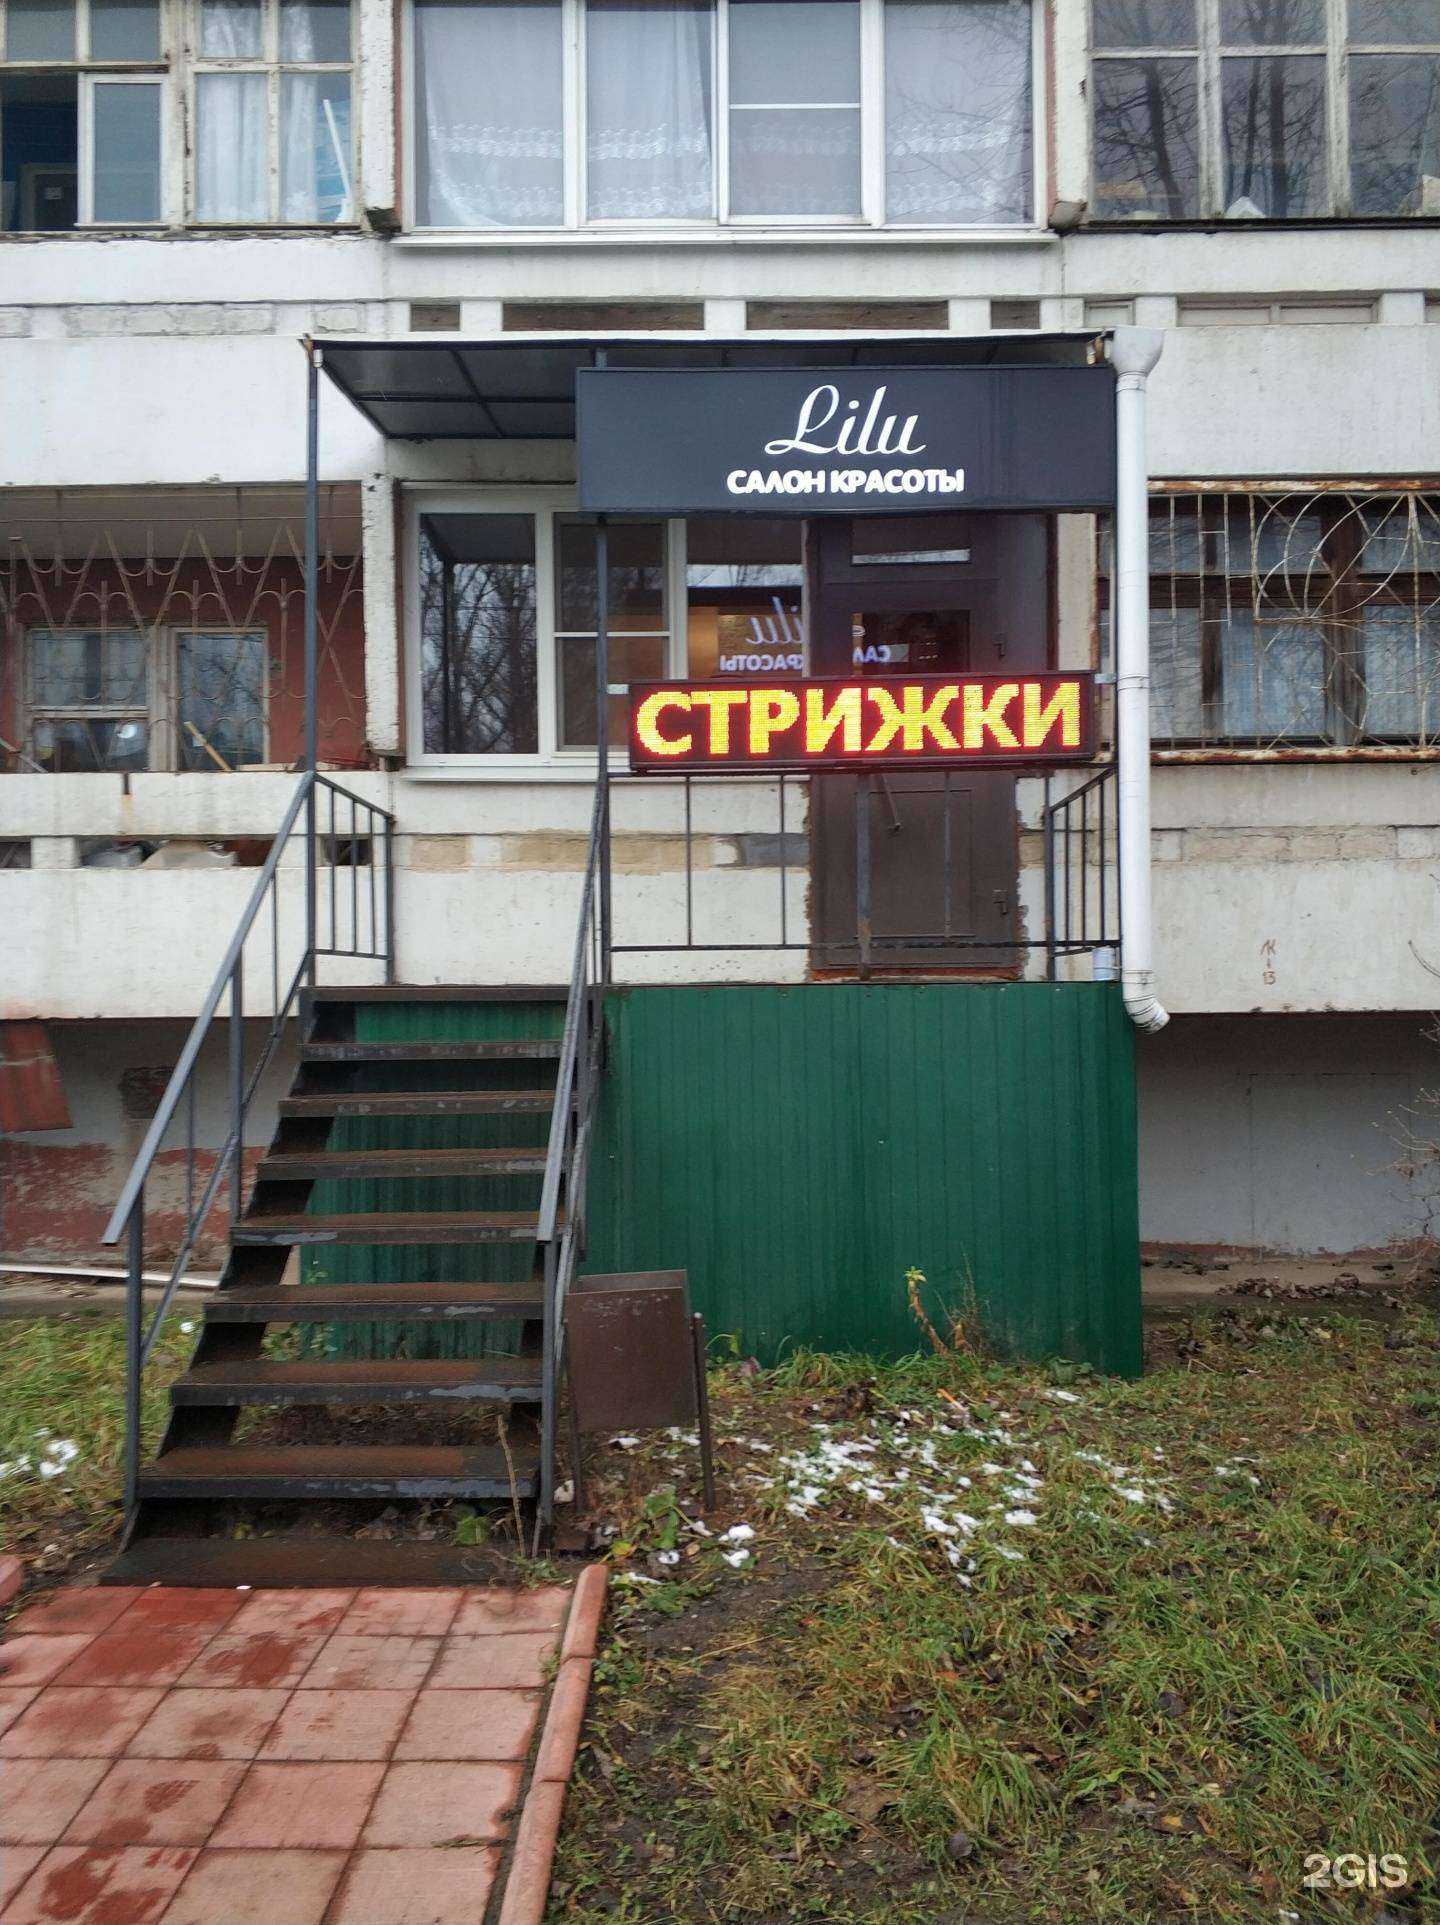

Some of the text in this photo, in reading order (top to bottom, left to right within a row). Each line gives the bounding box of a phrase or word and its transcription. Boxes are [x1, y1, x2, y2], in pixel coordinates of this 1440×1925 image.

[764, 385, 926, 455] Lilu
[726, 469, 965, 495] САЛОН КРАСОТЫ
[635, 682, 1081, 755] СТРИЖКИ
